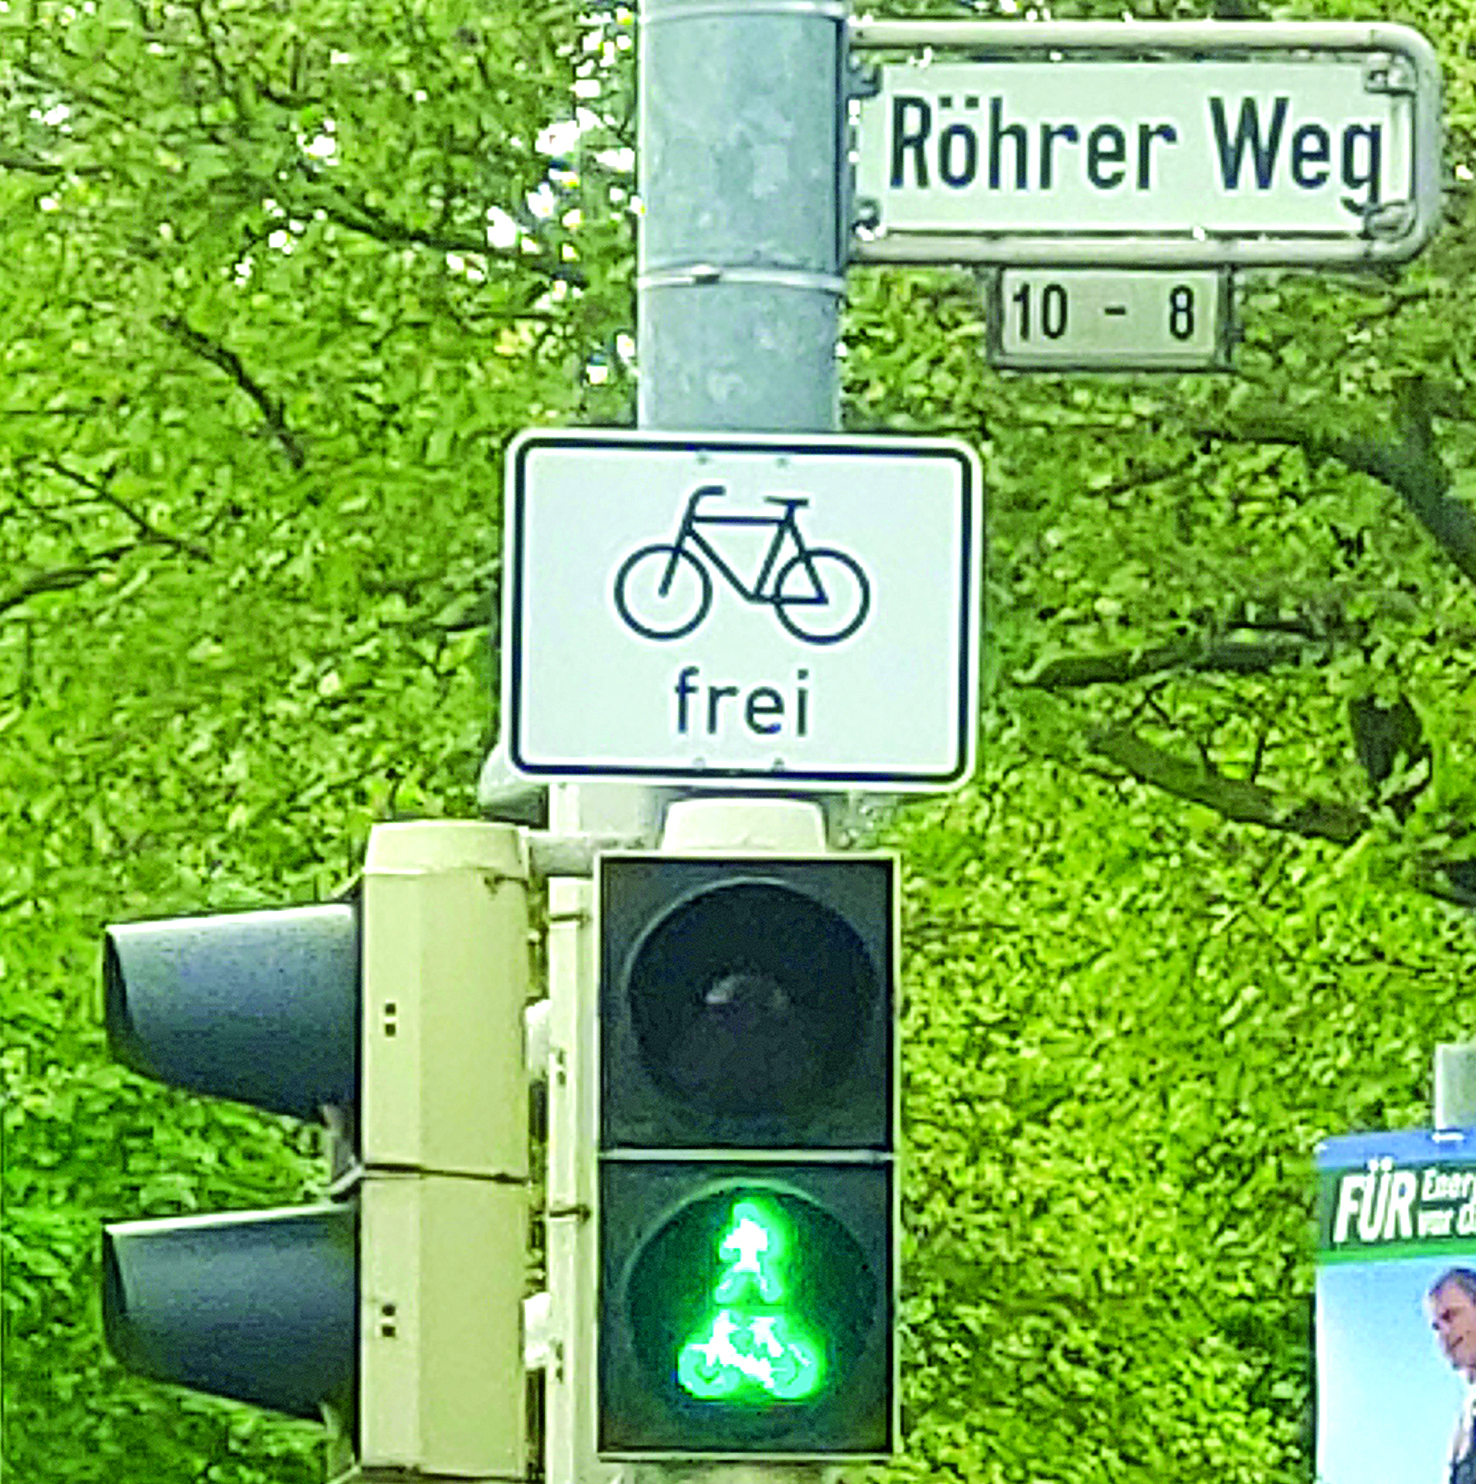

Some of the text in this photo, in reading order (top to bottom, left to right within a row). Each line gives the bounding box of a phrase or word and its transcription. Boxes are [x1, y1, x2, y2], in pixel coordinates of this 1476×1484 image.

[889, 95, 1382, 216] Röhrer Weg
[1012, 282, 1196, 342] 10 - 8
[674, 665, 809, 737] frei
[1332, 1155, 1417, 1243] FÜR
